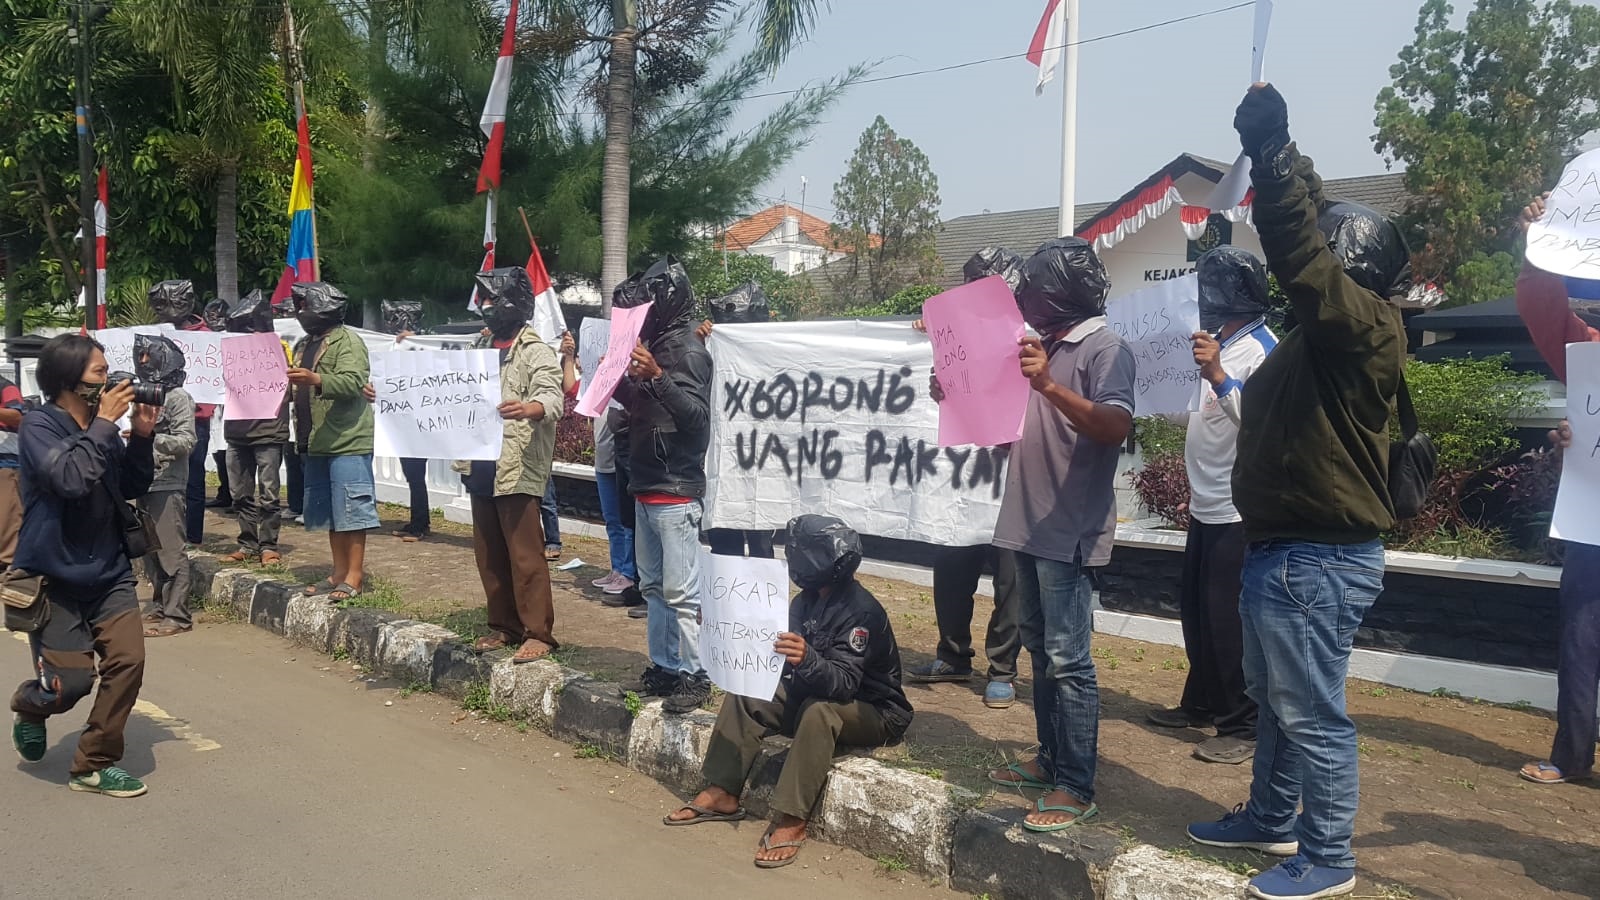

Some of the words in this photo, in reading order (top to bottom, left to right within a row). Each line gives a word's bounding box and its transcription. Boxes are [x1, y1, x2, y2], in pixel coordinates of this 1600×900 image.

[385, 371, 489, 394] SELAMATKAN
[380, 399, 414, 414] DANA
[421, 393, 484, 408] BANSOS
[735, 428, 843, 488] UANG
